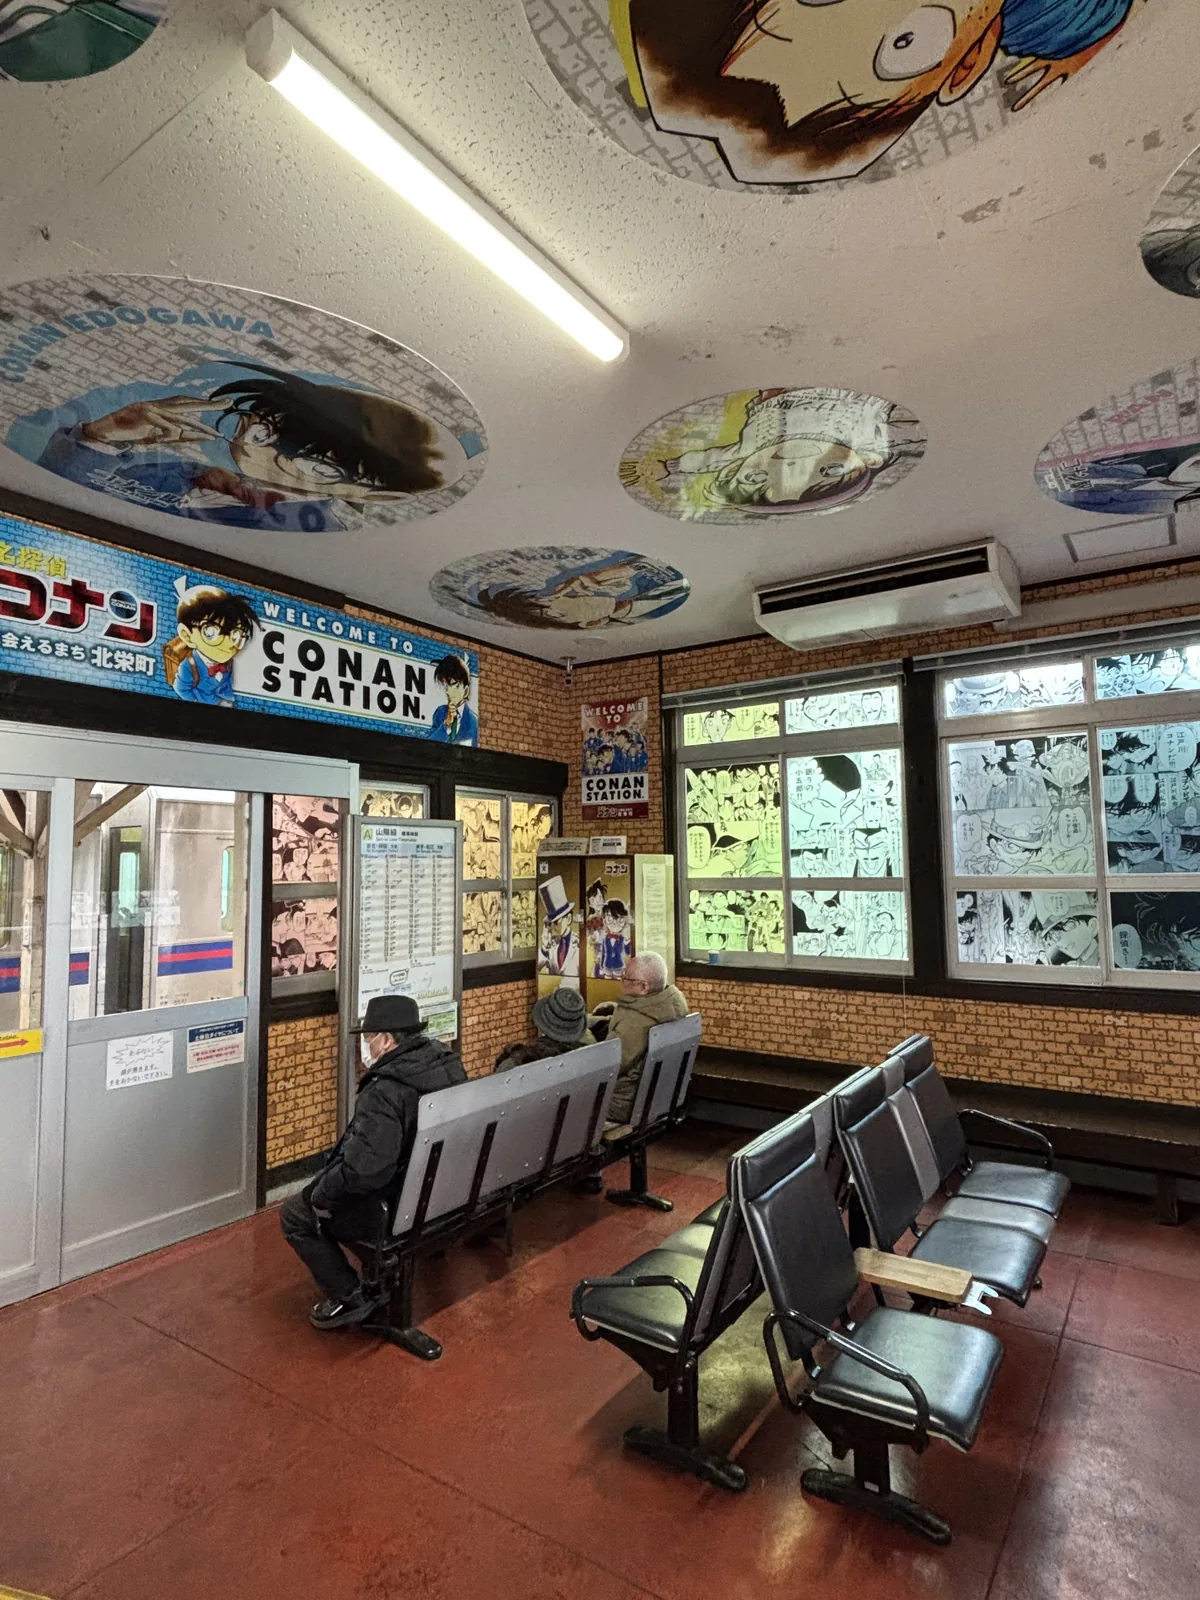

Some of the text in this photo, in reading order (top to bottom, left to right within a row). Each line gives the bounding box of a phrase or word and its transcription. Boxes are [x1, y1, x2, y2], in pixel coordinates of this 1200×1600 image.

[62, 306, 275, 339] EDOGAWA
[525, 553, 586, 562] KUDO
[0, 568, 154, 645] コナン
[263, 601, 413, 654] WELCOME TO
[2, 632, 156, 676] 会えるまち 北栄町
[262, 630, 426, 695] CONAN
[261, 665, 426, 721] STATION.
[584, 701, 644, 717] WELCOME
[605, 715, 621, 724] TO
[586, 776, 644, 791] CONAN
[605, 863, 628, 874] コナン
